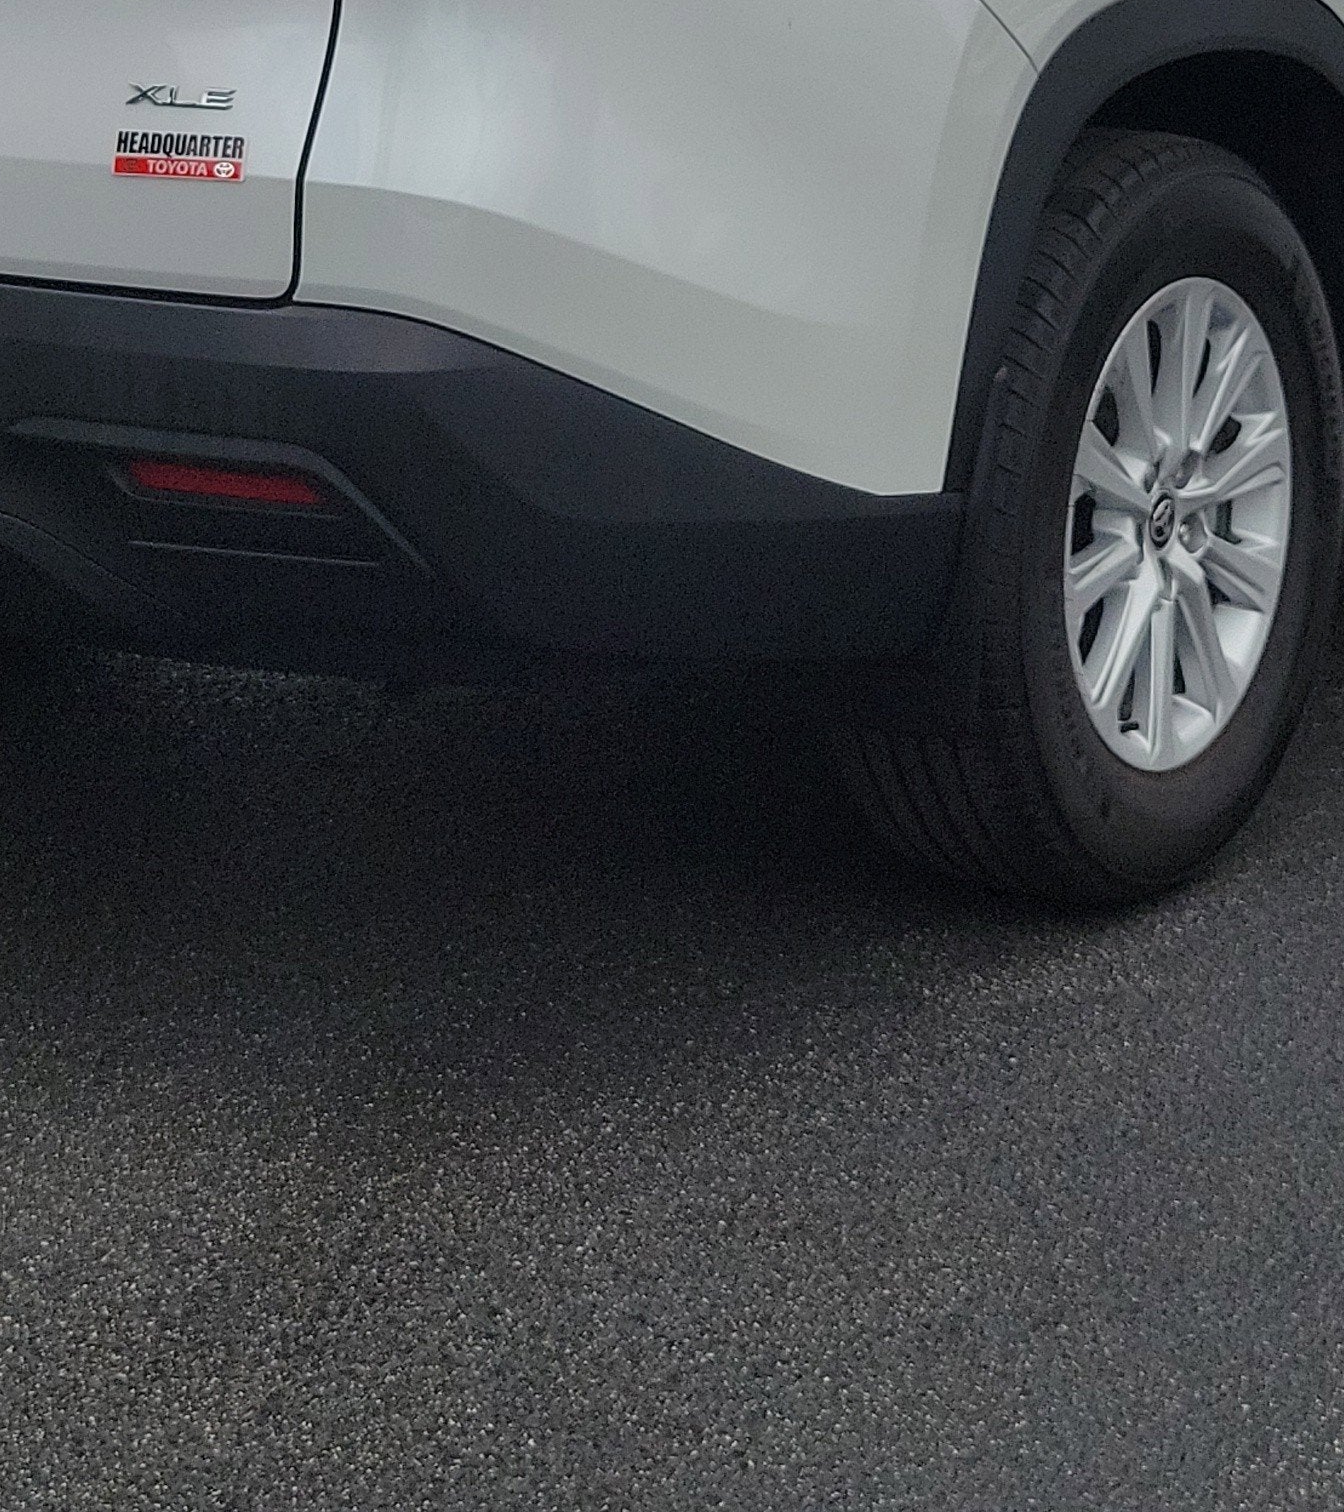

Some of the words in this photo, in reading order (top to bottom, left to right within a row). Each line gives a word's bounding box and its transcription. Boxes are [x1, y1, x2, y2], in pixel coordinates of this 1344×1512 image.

[126, 83, 237, 110] XLE
[116, 130, 245, 159] HEADQUARTER
[146, 159, 208, 176] TOYOTA
